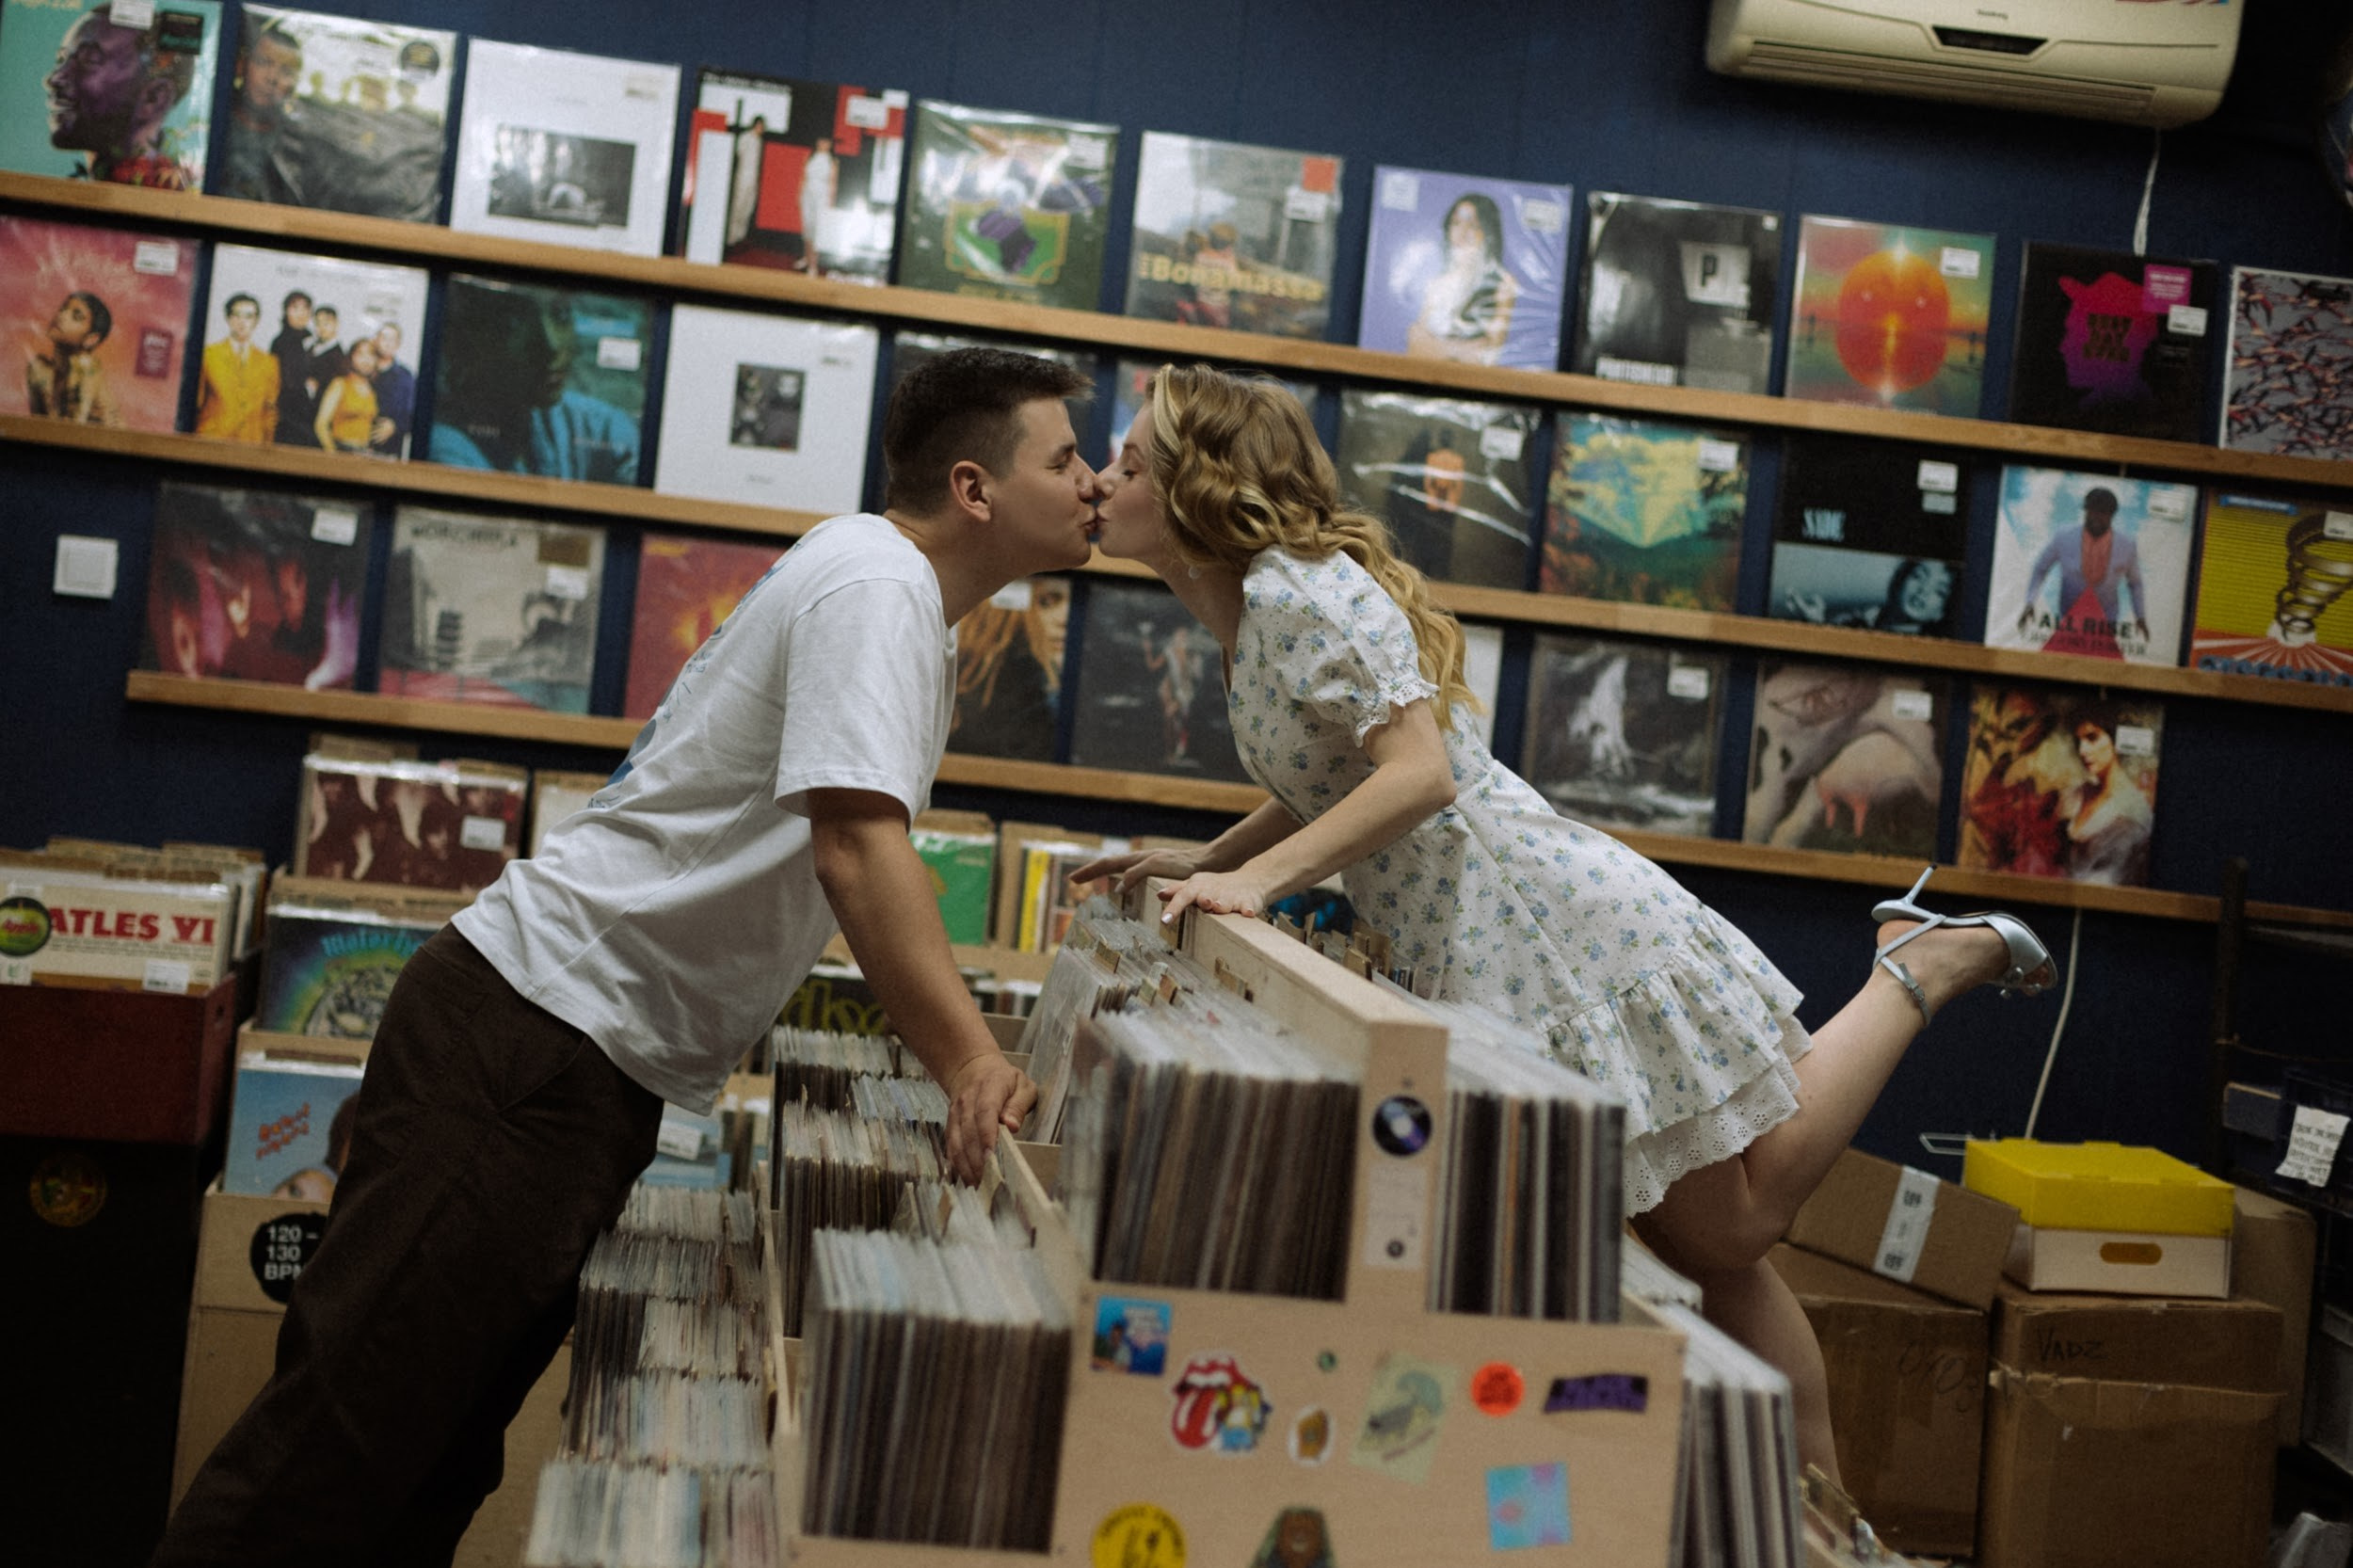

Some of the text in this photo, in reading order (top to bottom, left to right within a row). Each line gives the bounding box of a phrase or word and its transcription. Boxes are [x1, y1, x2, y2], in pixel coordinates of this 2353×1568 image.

[1702, 253, 1719, 287] P
[2039, 613, 2133, 640] ALL RISE
[171, 914, 216, 946] VI
[265, 1224, 302, 1242] 120
[265, 1243, 302, 1262] 130
